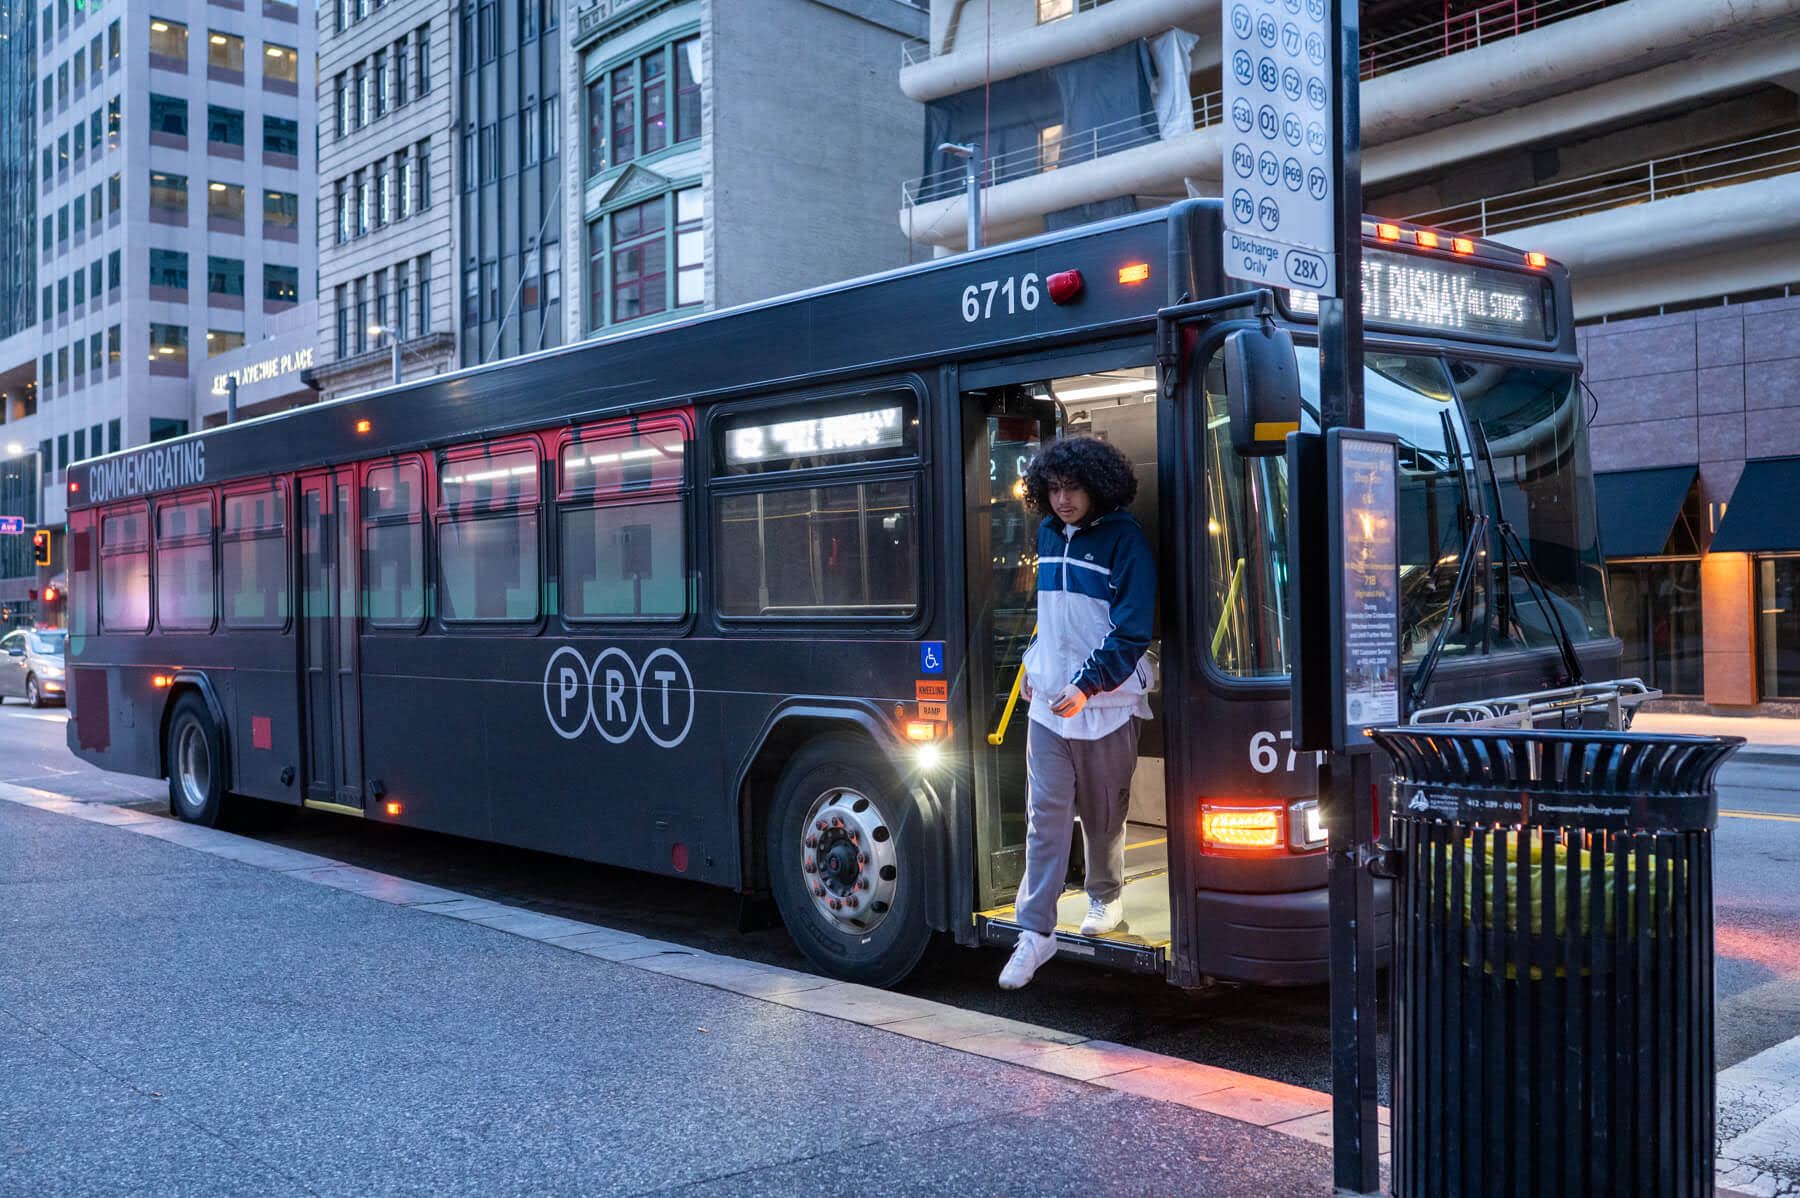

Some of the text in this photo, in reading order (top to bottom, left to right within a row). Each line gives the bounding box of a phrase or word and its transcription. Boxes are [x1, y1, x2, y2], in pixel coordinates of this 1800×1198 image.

[1235, 11, 1322, 60] 67 69 77 81
[1236, 57, 1324, 104] 82 83 G2 G3
[1235, 151, 1324, 193] P10 P17 P69 P7
[1235, 198, 1278, 223] P76 P78
[1231, 235, 1279, 261] Discharge
[1243, 256, 1268, 277] Only
[1293, 257, 1319, 281] 28X
[961, 272, 1040, 323] 6716
[1389, 264, 1466, 328] BUSWAY
[1468, 288, 1487, 316] ALL
[1489, 292, 1524, 322] STOPS
[241, 358, 280, 385] AVENUE
[280, 347, 314, 375] PLACE
[88, 439, 206, 503] COMMEMORATING
[1249, 730, 1327, 774] 67
